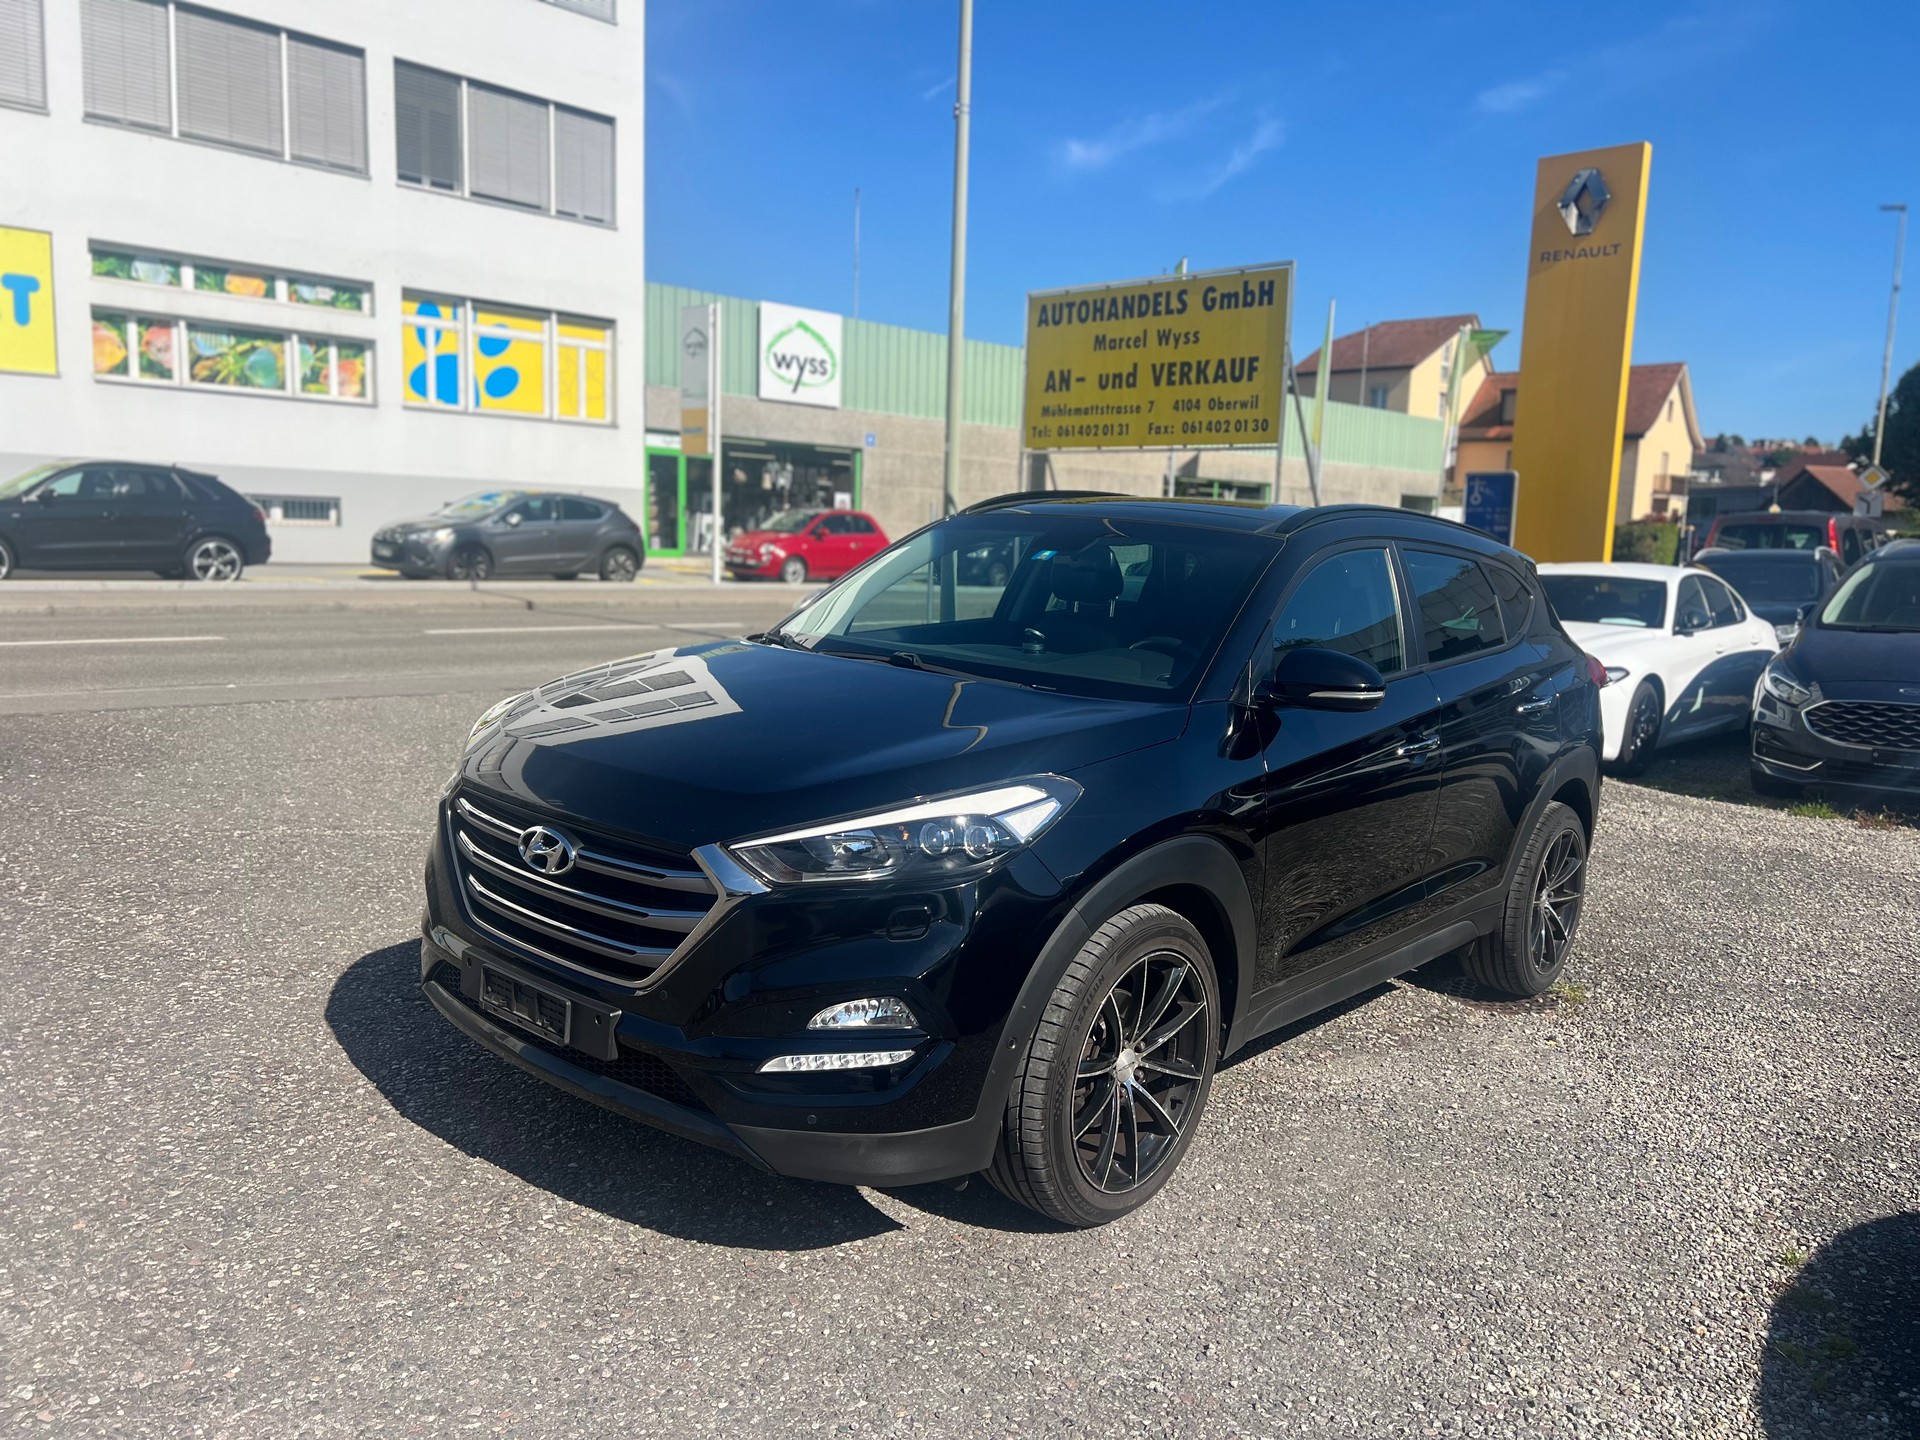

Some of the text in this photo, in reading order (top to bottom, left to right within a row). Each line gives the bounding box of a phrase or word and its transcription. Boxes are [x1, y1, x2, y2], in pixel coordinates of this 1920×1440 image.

[1540, 242, 1621, 262] RENAULT
[1037, 279, 1275, 328] AUTOHANDELS GmbH
[1093, 328, 1200, 352] Marcel Wyss
[773, 351, 828, 394] wyss
[1044, 356, 1260, 393] AN- und VERKAUF
[1148, 400, 1155, 413] 7
[1173, 398, 1201, 412] 4104
[1208, 395, 1259, 411] Oberwil
[1032, 425, 1051, 438] Tel:
[1148, 422, 1174, 435] Fax:
